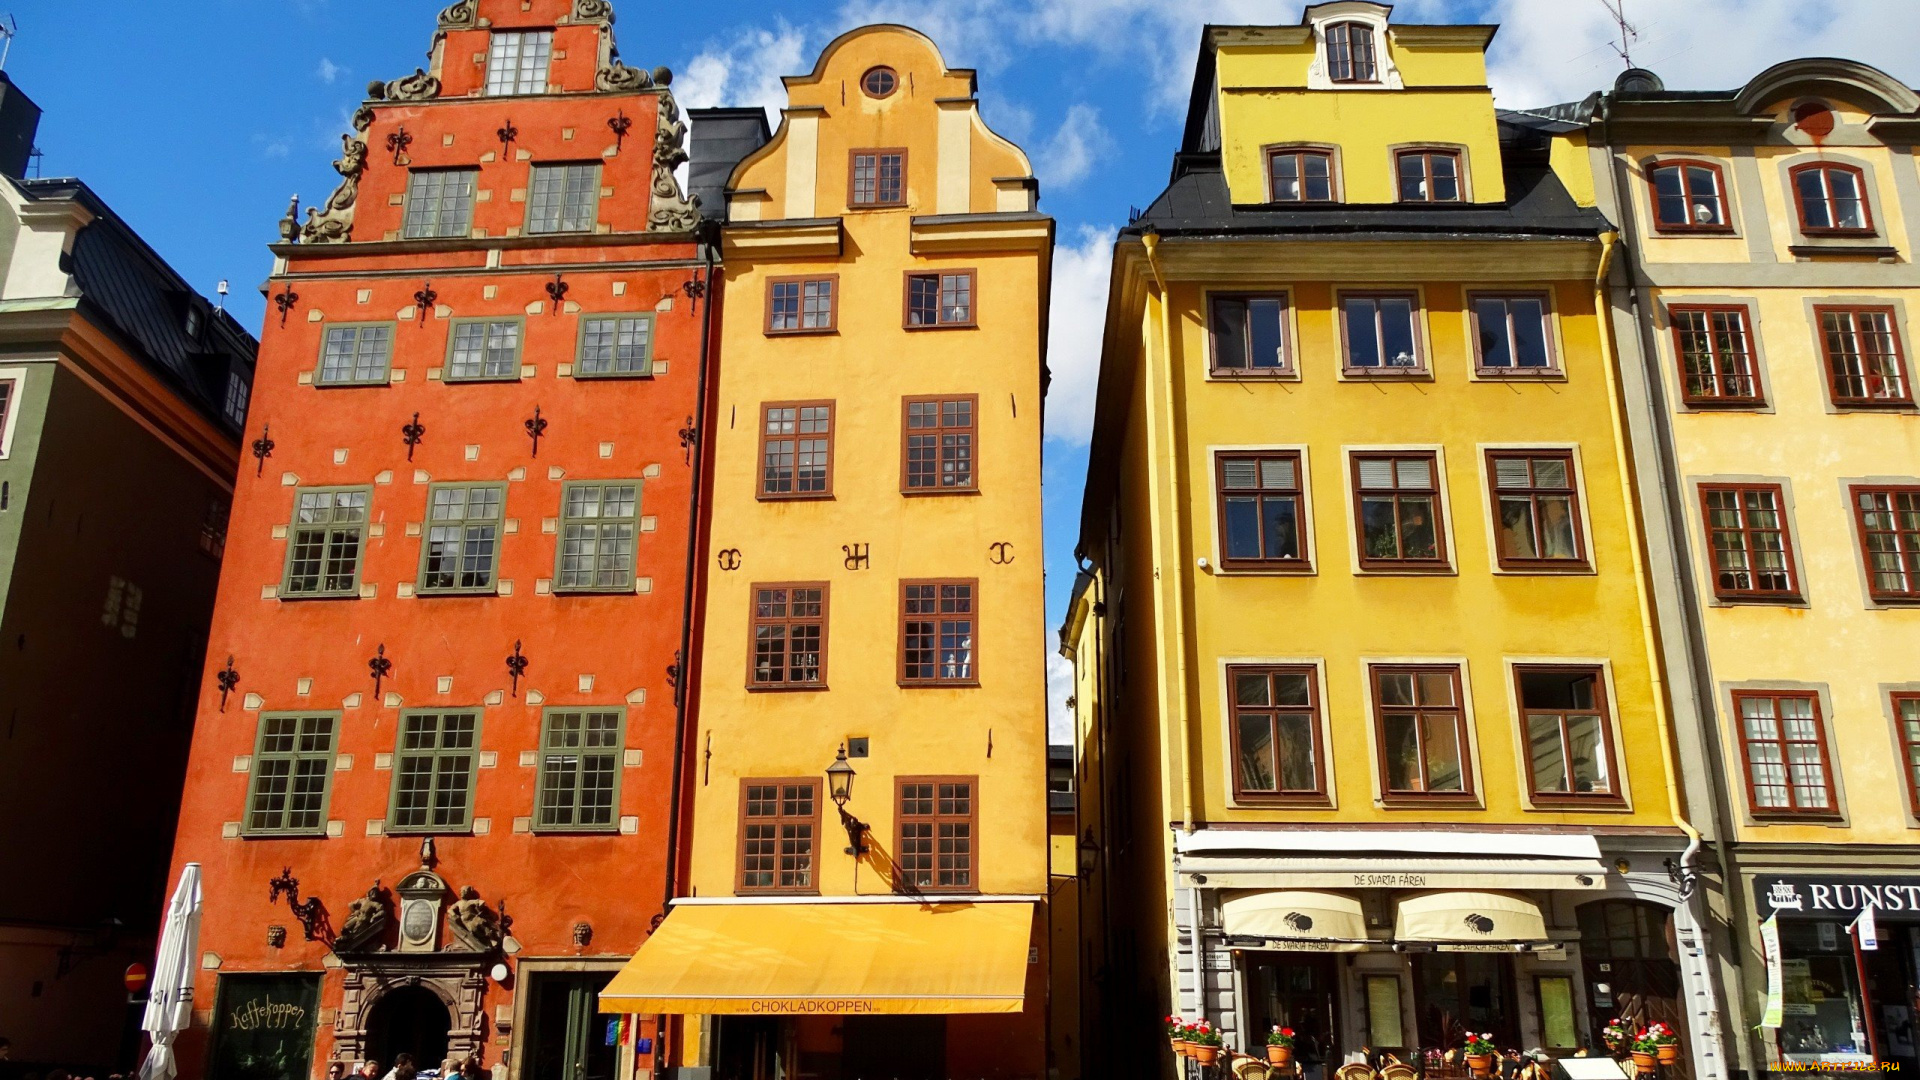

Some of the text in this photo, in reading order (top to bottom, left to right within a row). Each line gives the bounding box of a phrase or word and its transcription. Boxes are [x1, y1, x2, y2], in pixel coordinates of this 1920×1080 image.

[1354, 874, 1365, 886] DE
[1367, 874, 1396, 886] SVARTA
[229, 993, 305, 1030] Kaffekoppen
[751, 1000, 872, 1013] CHOKLADKOPPEN
